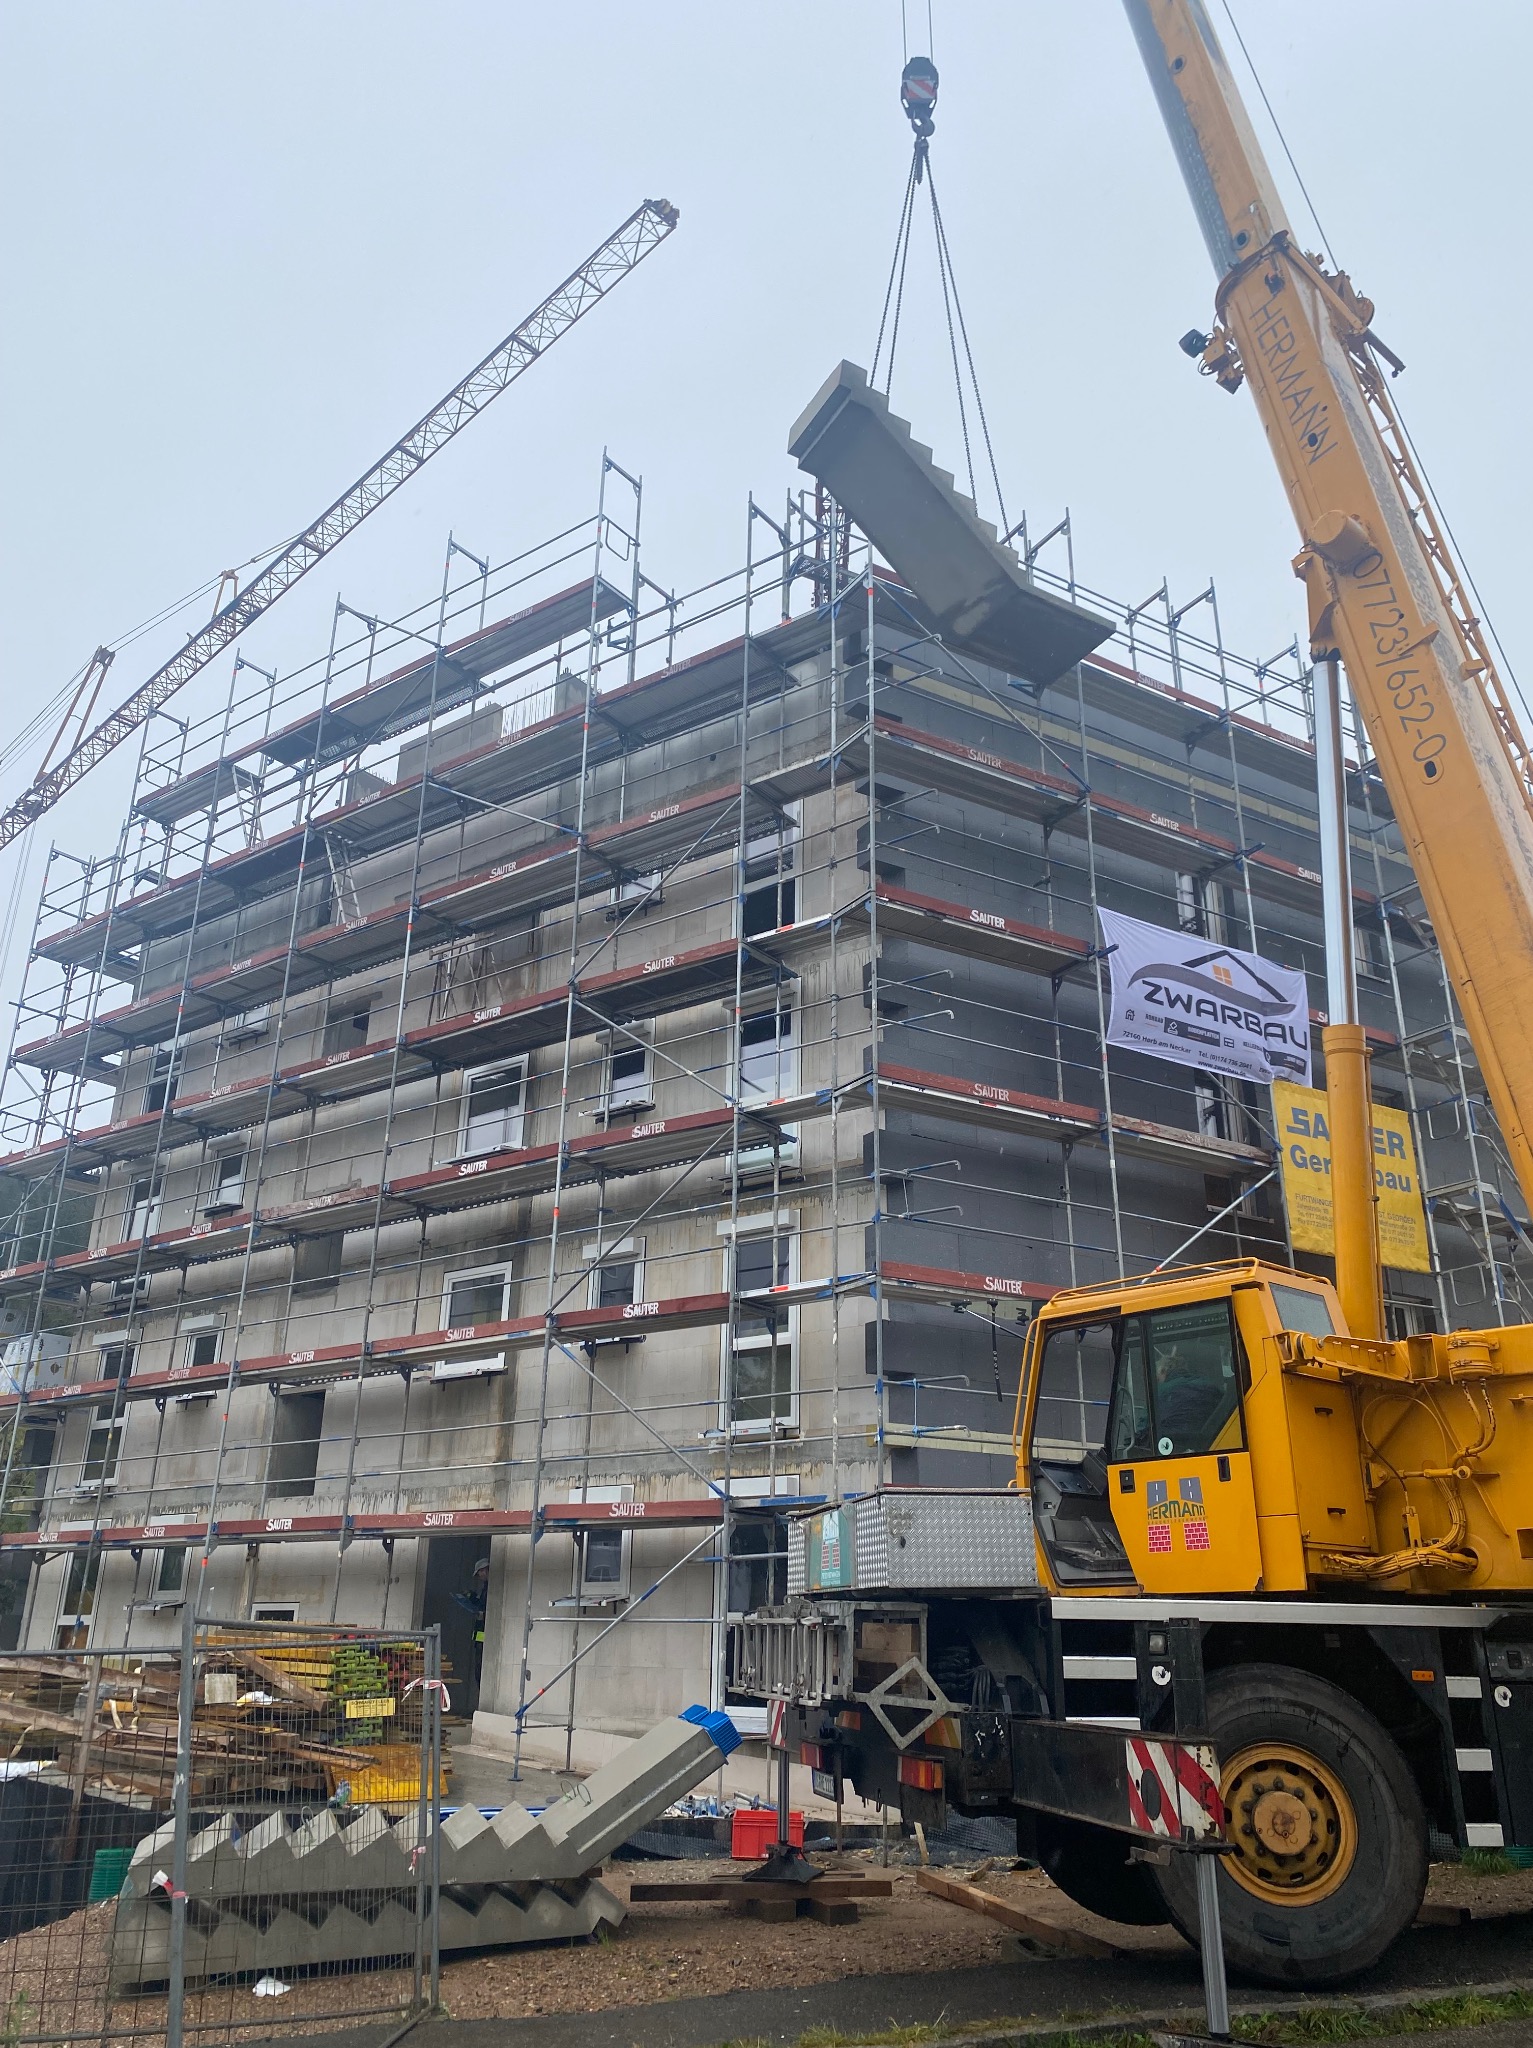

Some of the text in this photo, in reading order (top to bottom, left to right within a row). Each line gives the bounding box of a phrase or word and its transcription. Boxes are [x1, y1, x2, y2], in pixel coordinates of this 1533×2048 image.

[1249, 296, 1338, 465] HERMANN
[508, 607, 533, 624] SAUTER
[661, 660, 691, 678] SAUTER
[1138, 673, 1166, 692] SAUTER
[968, 749, 1001, 768] SAUTER
[357, 791, 381, 806] SAUTER
[649, 805, 679, 822] SAUTER
[1150, 813, 1179, 831] SAUTER
[489, 862, 516, 878] SAUTER
[1298, 867, 1322, 883] SAUTE
[344, 917, 366, 931] SAUTER
[970, 910, 1005, 929] SAUTER
[231, 959, 251, 973] SAUTER
[643, 957, 674, 973] SAUTER
[472, 1006, 500, 1023] SAUTER
[1142, 980, 1308, 1050] ZWARBAU
[1142, 1036, 1157, 1046] Horb
[1170, 1043, 1192, 1054] Neckar
[326, 1051, 350, 1065] SAUTER
[210, 1086, 231, 1098] SAUTER
[973, 1084, 1009, 1101] SAUTER
[110, 1120, 128, 1131] SAUTER
[632, 1122, 665, 1138] SAUTER
[459, 1160, 487, 1176] SAUTER
[308, 1196, 331, 1209] SAUTER
[1295, 1193, 1333, 1207] FURTWANGE
[190, 1223, 211, 1236] SAUTER
[88, 1248, 107, 1259] SAUTER
[984, 1277, 1021, 1294] SAUTER
[623, 1303, 659, 1317] SAUTER
[445, 1328, 474, 1341] SAUTER
[289, 1351, 314, 1364] SAUTER
[168, 1369, 190, 1380] SAUTER
[62, 1385, 81, 1396] SAUTER
[609, 1504, 645, 1517] SAUTER
[1148, 1501, 1206, 1520] HERMANN
[266, 1519, 292, 1531] SAUTER
[424, 1514, 453, 1527] SAUTER
[38, 1533, 58, 1543] SAUTER
[142, 1527, 165, 1537] SAUTER
